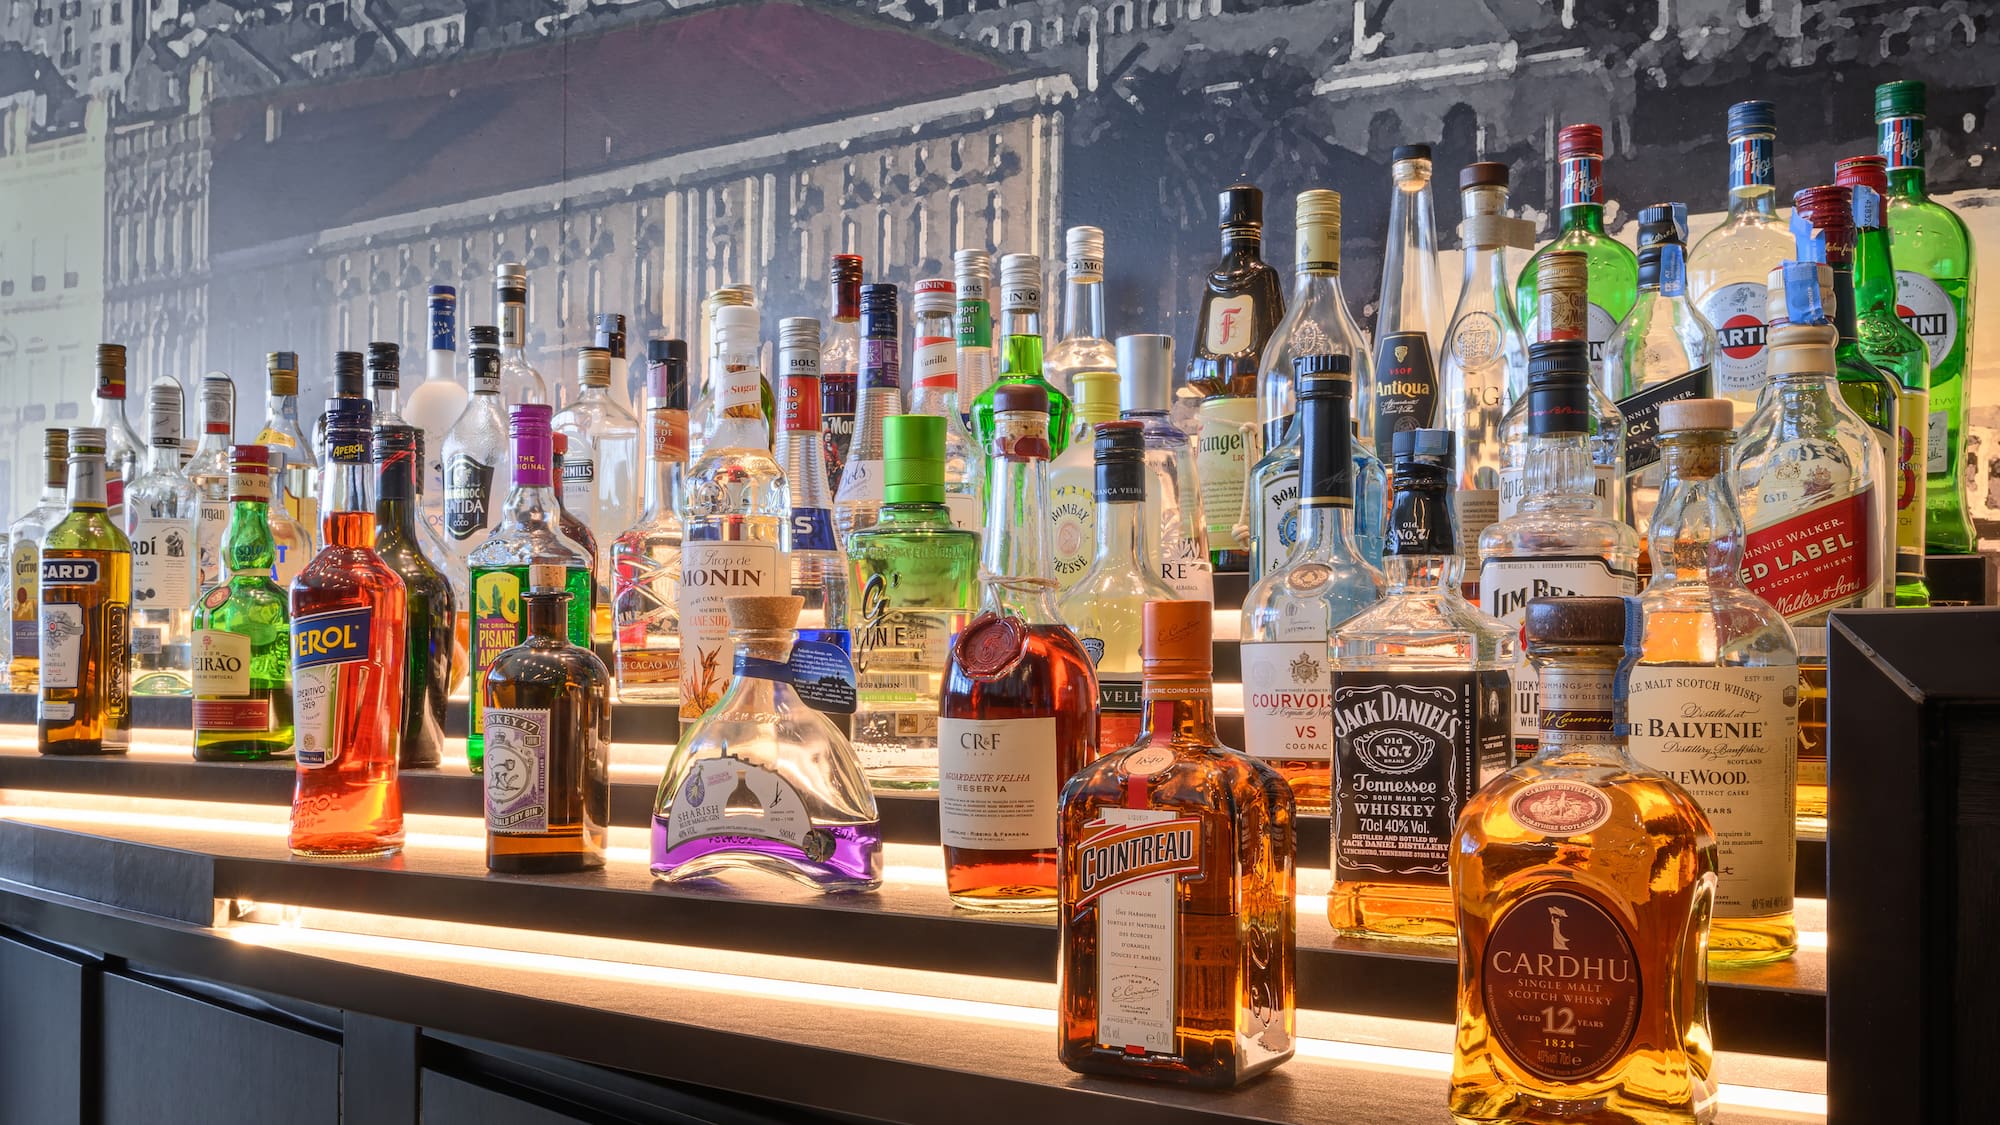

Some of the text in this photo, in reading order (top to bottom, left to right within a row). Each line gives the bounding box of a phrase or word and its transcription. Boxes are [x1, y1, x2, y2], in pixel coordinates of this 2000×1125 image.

[1220, 307, 1241, 344] F
[1719, 326, 1765, 348] ARTI
[791, 359, 816, 367] BOLS
[731, 383, 757, 394] Sugar
[1376, 381, 1430, 398] Antiqua
[1625, 406, 1652, 422] NNIE
[333, 443, 364, 458] APEROL
[518, 455, 535, 463] THE
[1271, 486, 1297, 506] BOM
[1052, 503, 1090, 525] BOMBAY
[1785, 518, 1840, 544] WALKER
[1740, 533, 1854, 584] ED LABEL
[43, 562, 91, 579] CARD
[682, 568, 762, 588] MONIN
[1770, 555, 1854, 589] SCOTCH WHISKY
[1494, 587, 1528, 618] JIM
[1774, 588, 1823, 614] Walker
[289, 624, 358, 657] PEROL
[479, 629, 516, 648] PISANG
[193, 655, 242, 672] EIRÃO
[631, 660, 663, 670] CACAO
[1517, 681, 1540, 692] UCKY
[1645, 678, 1673, 691] MALT
[1676, 678, 1721, 691] SCOTCH
[1724, 682, 1762, 704] WHISKY
[1333, 699, 1377, 738] JACK
[1381, 691, 1462, 740] DANIEL'S
[1680, 701, 1735, 719] Distilled
[520, 718, 537, 732] 47
[1295, 726, 1318, 739] VS
[1647, 718, 1764, 738] BALVENIE
[1383, 737, 1403, 745] Old
[1375, 745, 1412, 758] No.7
[995, 773, 1031, 783] VELHA
[1352, 773, 1437, 793] Tennessee
[957, 784, 1008, 793] RESERVA
[1525, 785, 1557, 798] CARDHU
[678, 805, 720, 823] SHARISH
[1354, 803, 1436, 818] WHISKEY
[1360, 818, 1430, 834] 70cl 40% Vol.
[1559, 818, 1595, 831] SCOTLAND
[1365, 841, 1397, 849] DANIEL
[1398, 842, 1449, 851] DISTILLERY
[1081, 829, 1193, 892] COINTREAU
[1119, 889, 1153, 897] L'UNIQUE
[1492, 950, 1629, 983] CARDHU
[1518, 978, 1603, 993] SINGLE MALT
[1508, 990, 1613, 1006] SCOTCH WHISKY
[1516, 1006, 1604, 1036] AGED 12 YEARS
[1544, 1038, 1575, 1049] 1824
